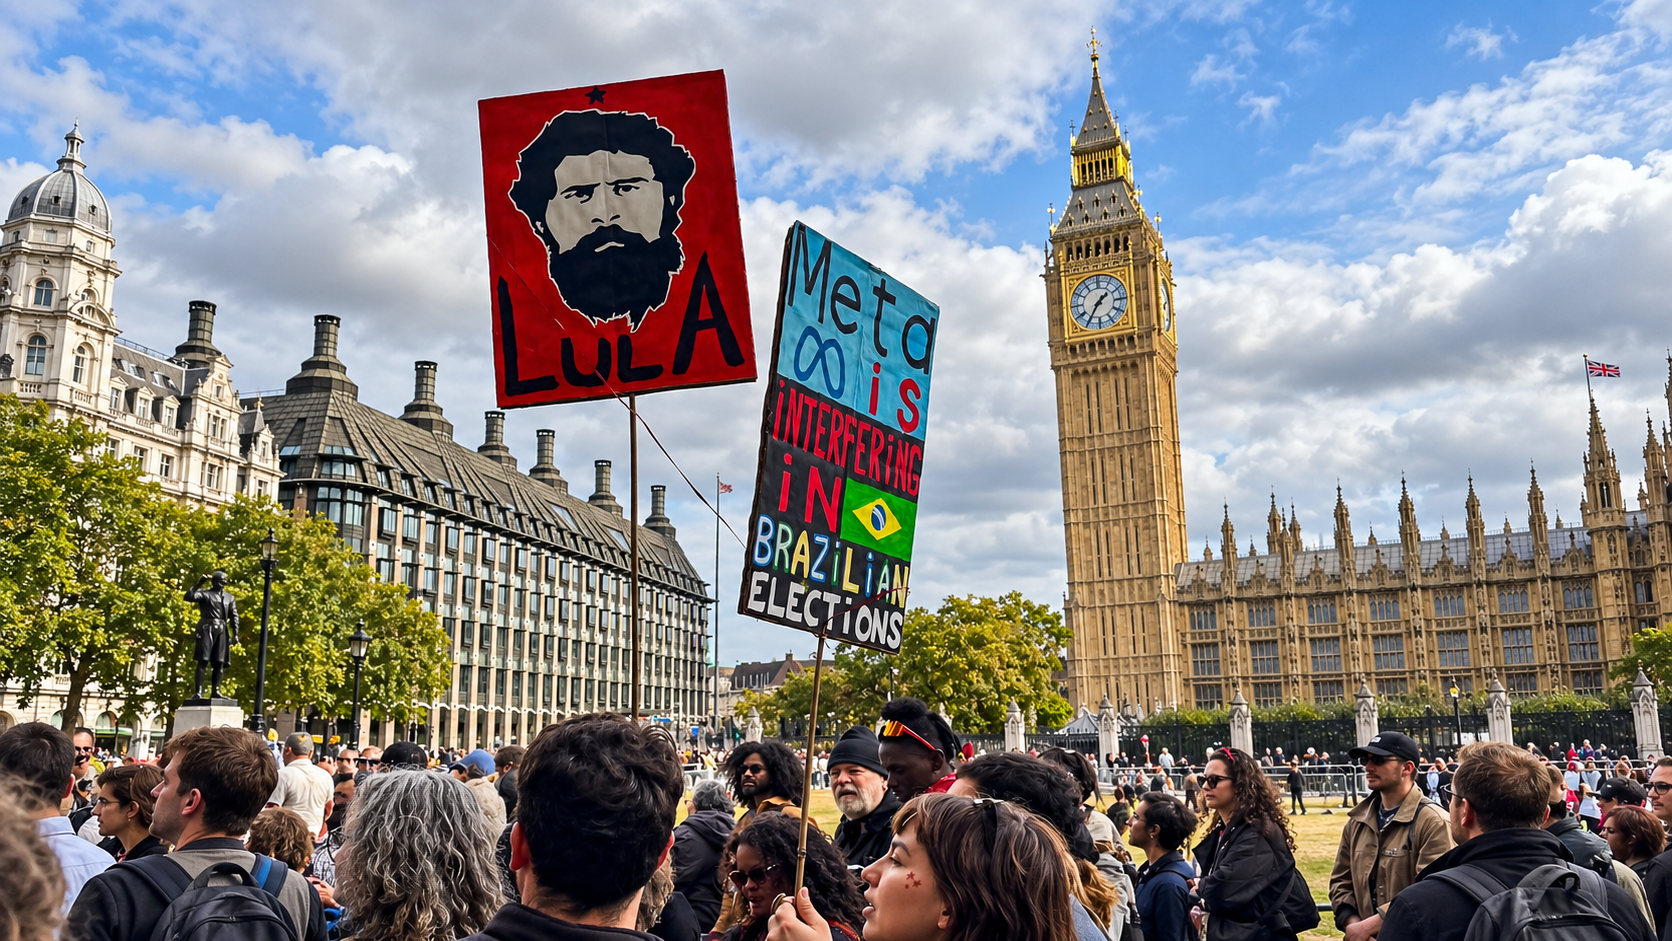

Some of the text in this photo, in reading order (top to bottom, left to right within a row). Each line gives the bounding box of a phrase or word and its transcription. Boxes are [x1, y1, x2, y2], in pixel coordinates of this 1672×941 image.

[497, 251, 745, 396] LULA
[788, 224, 935, 375] Meta
[869, 362, 921, 433] is
